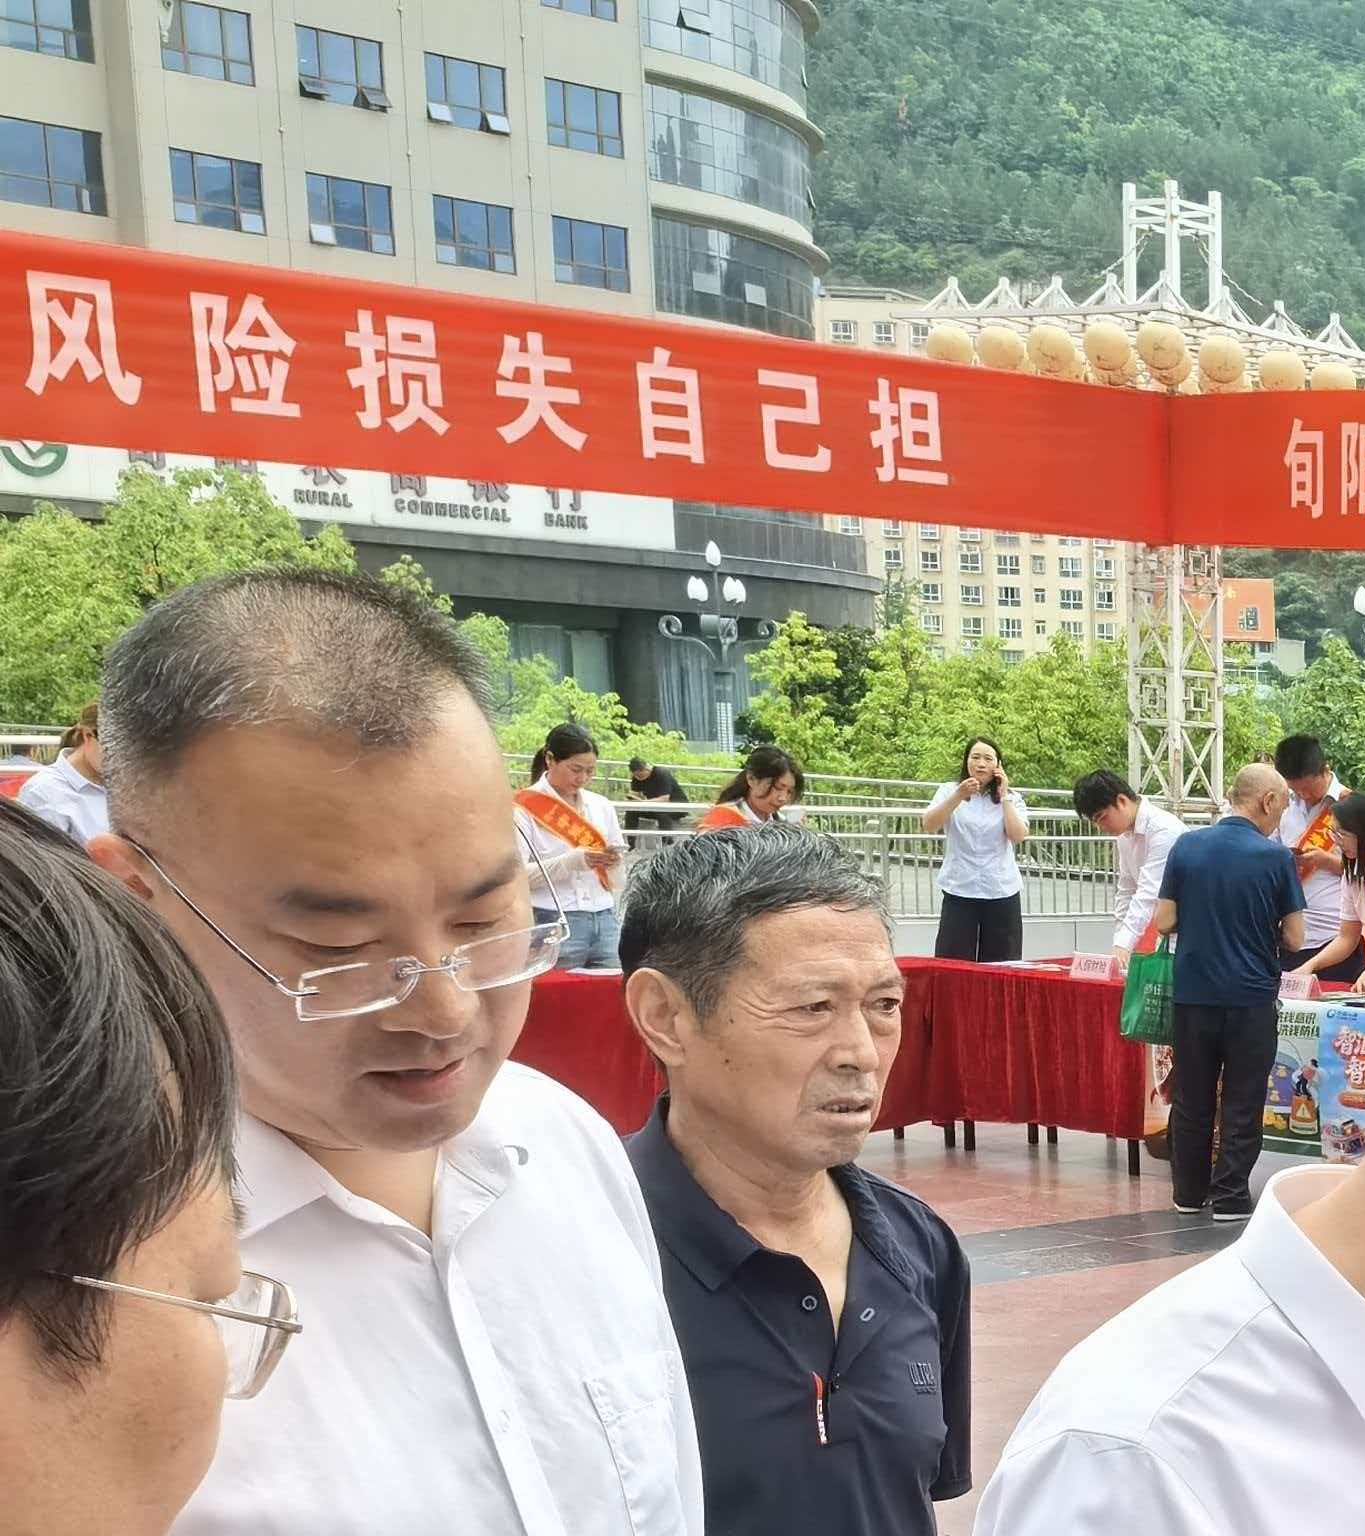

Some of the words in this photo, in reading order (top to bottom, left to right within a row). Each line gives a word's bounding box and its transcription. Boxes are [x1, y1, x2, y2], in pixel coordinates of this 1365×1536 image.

[25, 270, 950, 486] 风险损失自己担
[293, 488, 353, 509] RURAL
[394, 497, 512, 523] COMMERCIAL
[544, 511, 589, 530] BANK
